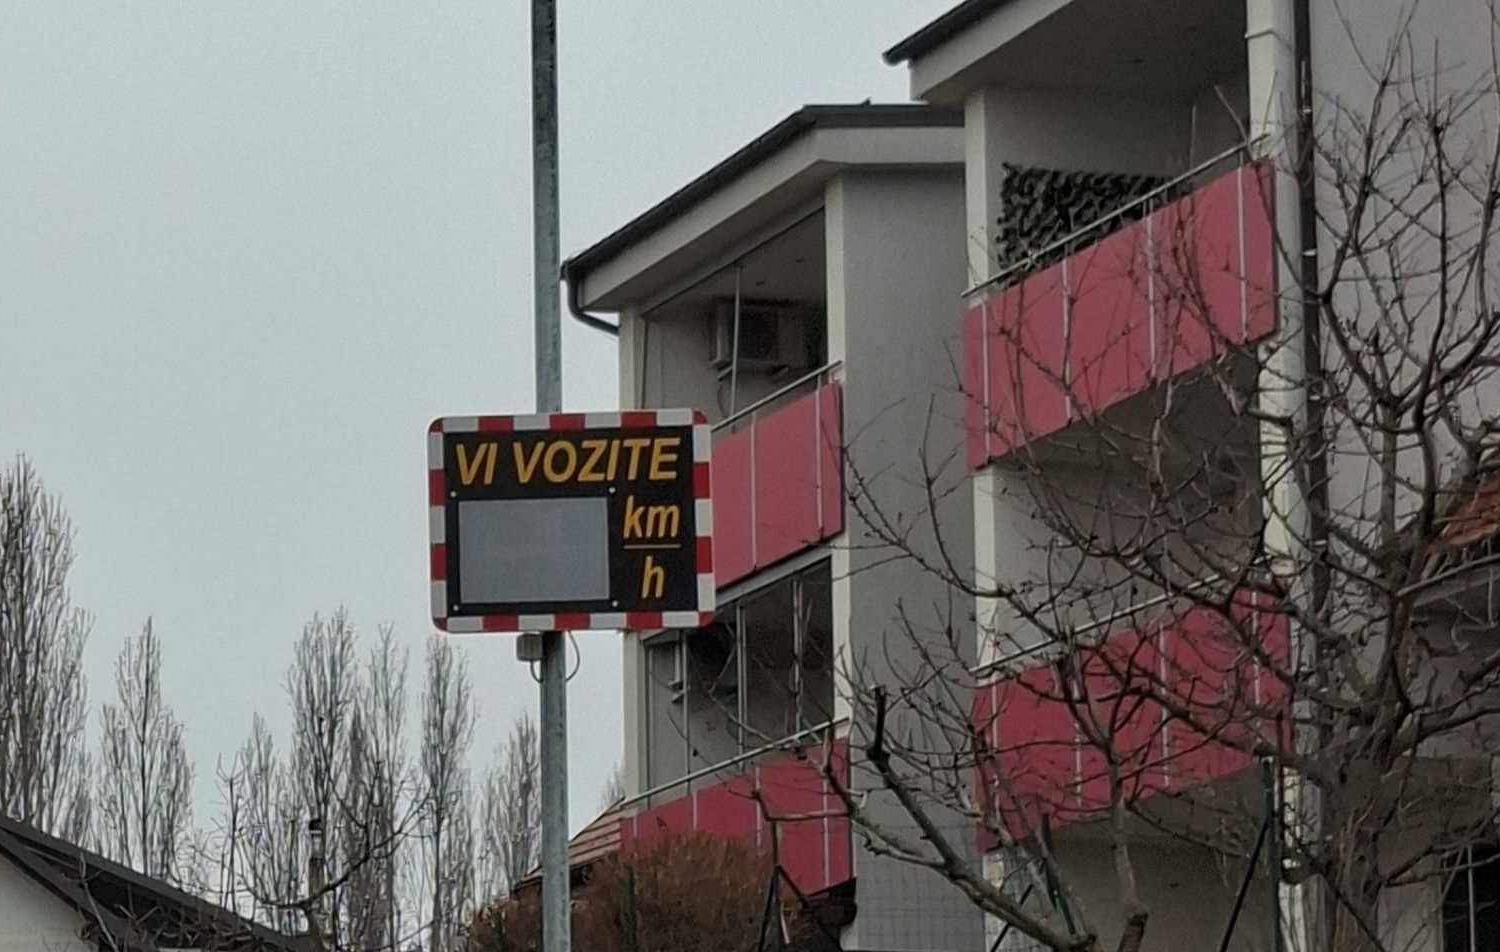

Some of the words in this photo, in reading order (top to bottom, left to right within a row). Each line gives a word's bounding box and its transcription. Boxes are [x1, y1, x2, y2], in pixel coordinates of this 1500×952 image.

[456, 442, 498, 486] VI
[513, 437, 681, 484] VOZITE
[623, 495, 680, 539] km
[641, 555, 665, 599] h
